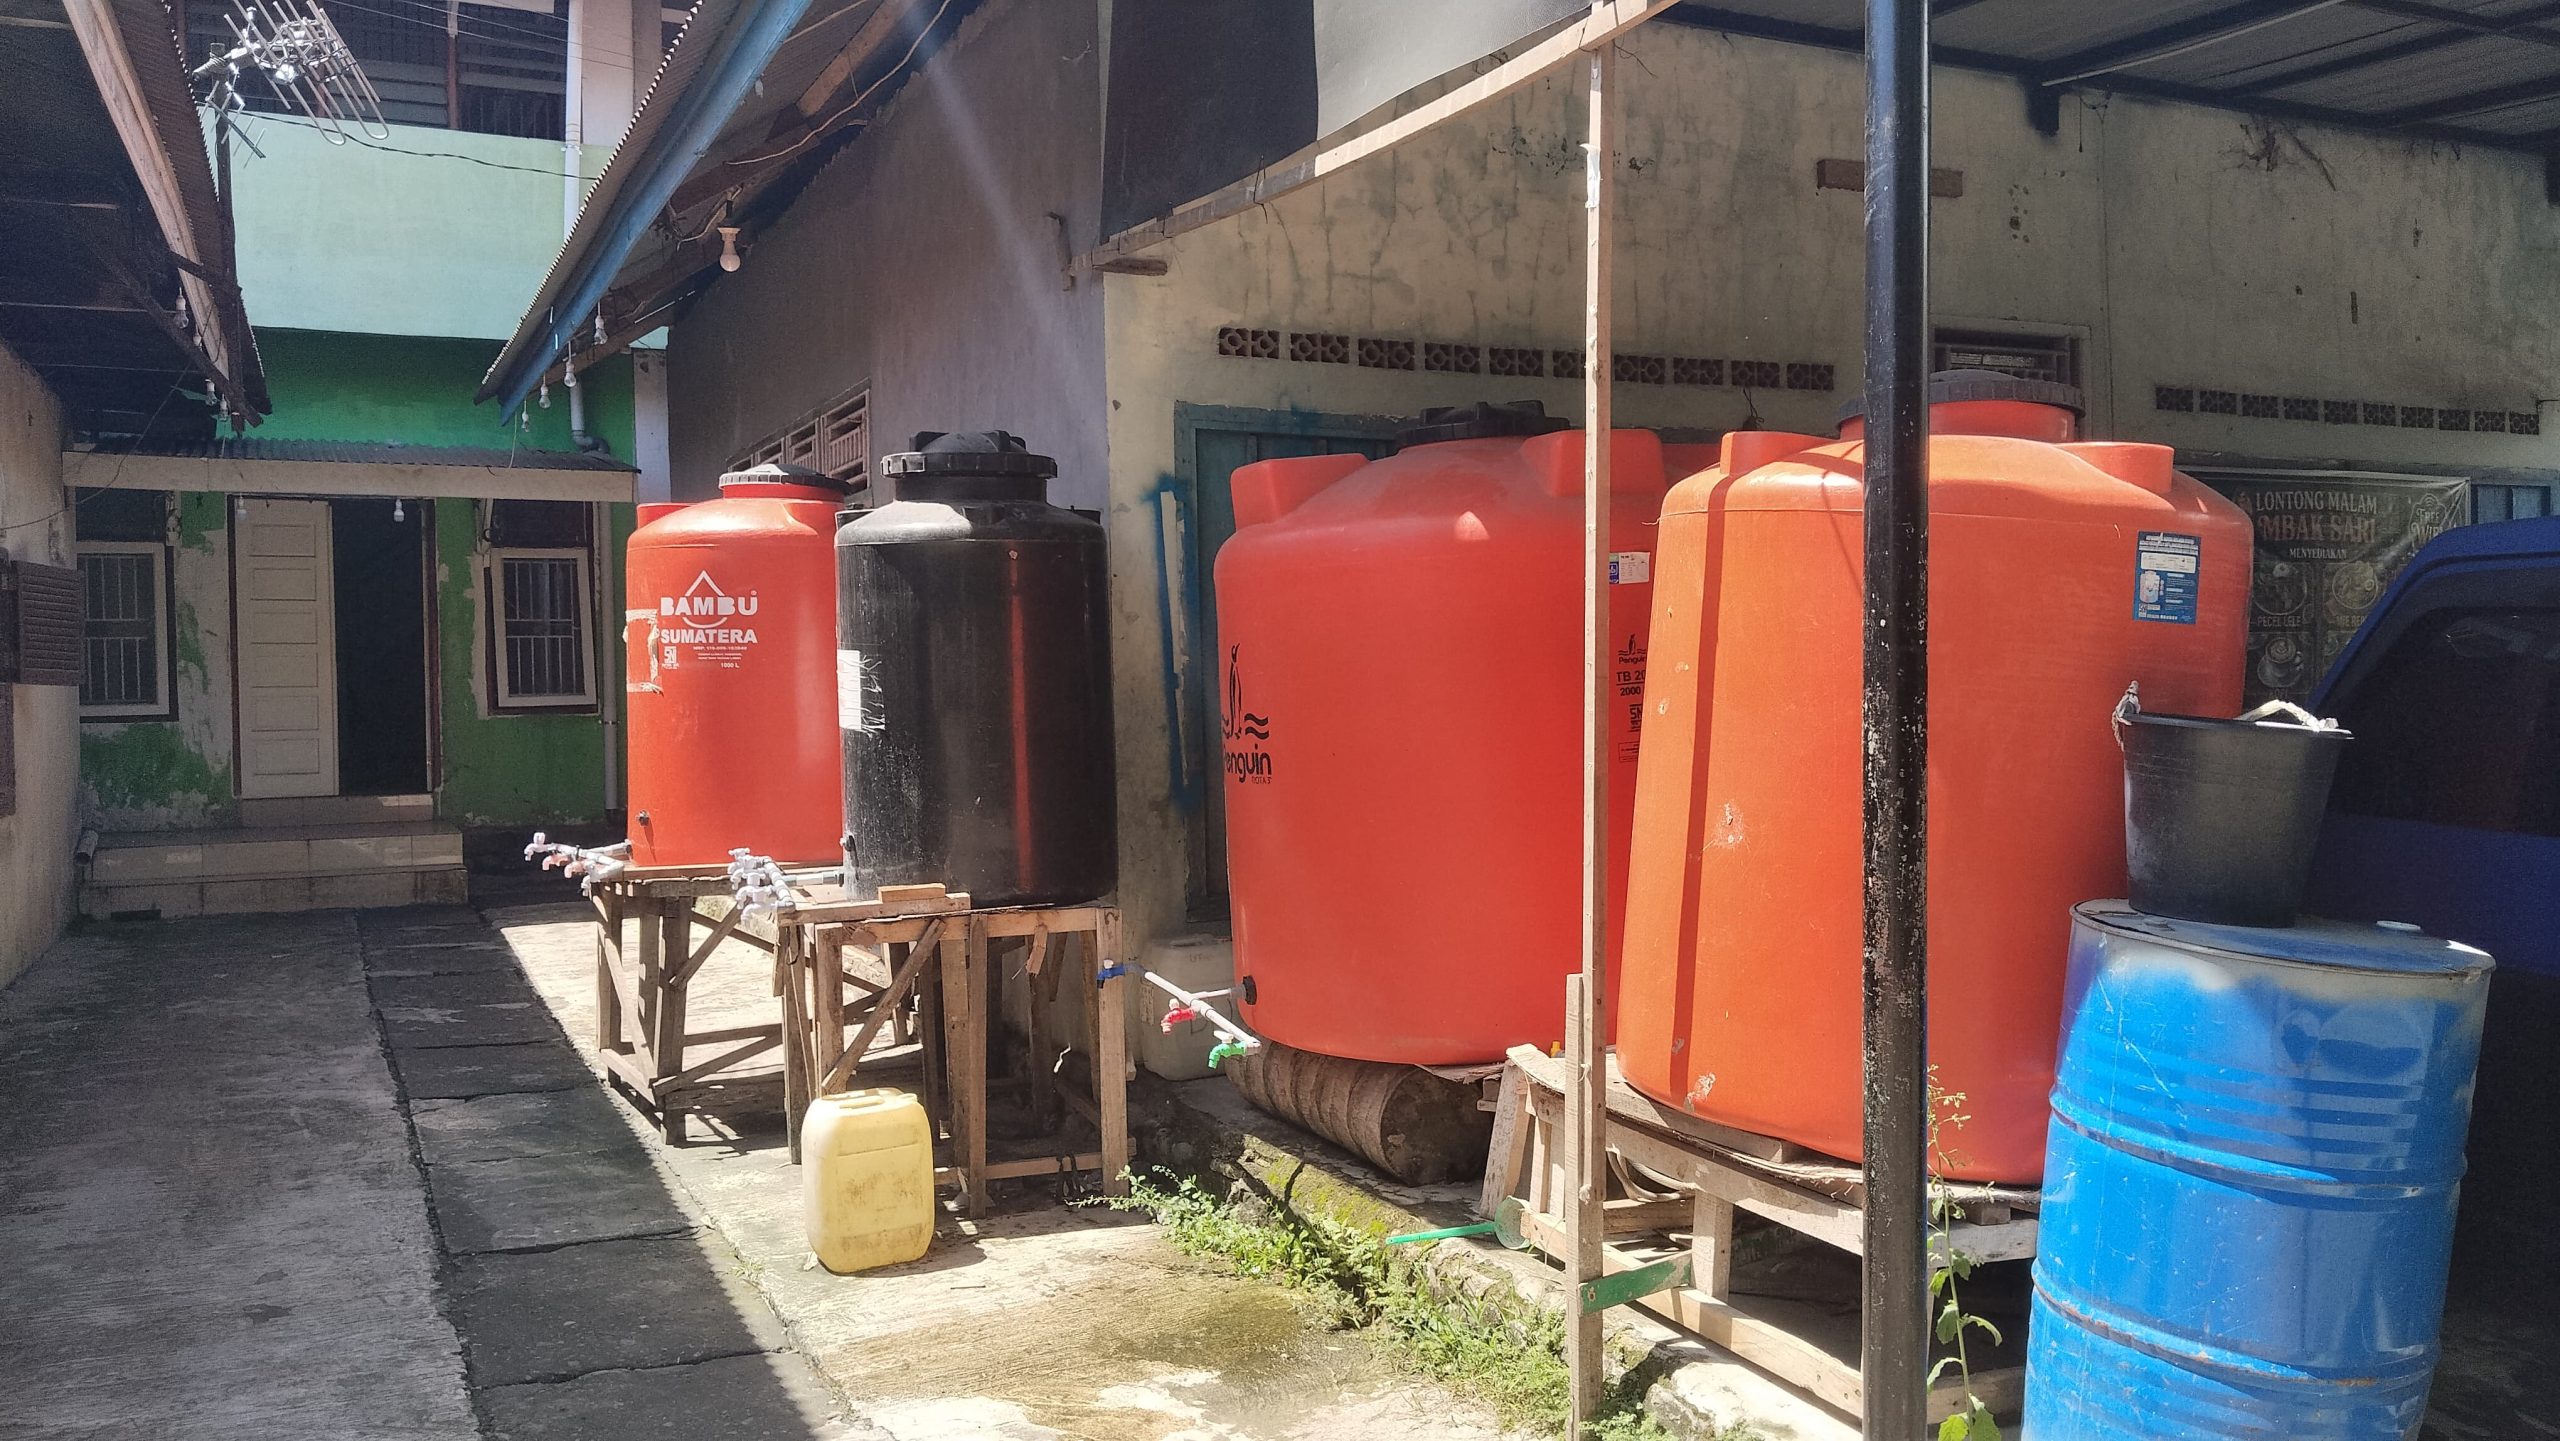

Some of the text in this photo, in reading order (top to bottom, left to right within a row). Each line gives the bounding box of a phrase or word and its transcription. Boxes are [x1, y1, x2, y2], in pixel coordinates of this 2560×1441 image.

[2256, 492, 2377, 514] LONTONG MALAM
[2257, 515, 2376, 543] MBAK SARI
[2289, 547, 2347, 559] MENYEDIAKAN
[660, 596, 758, 616] BAMBU
[660, 628, 758, 643] SUMATERA
[1616, 671, 1631, 682] TB
[1620, 686, 1641, 696] 2000
[1223, 743, 1272, 783] enguin
